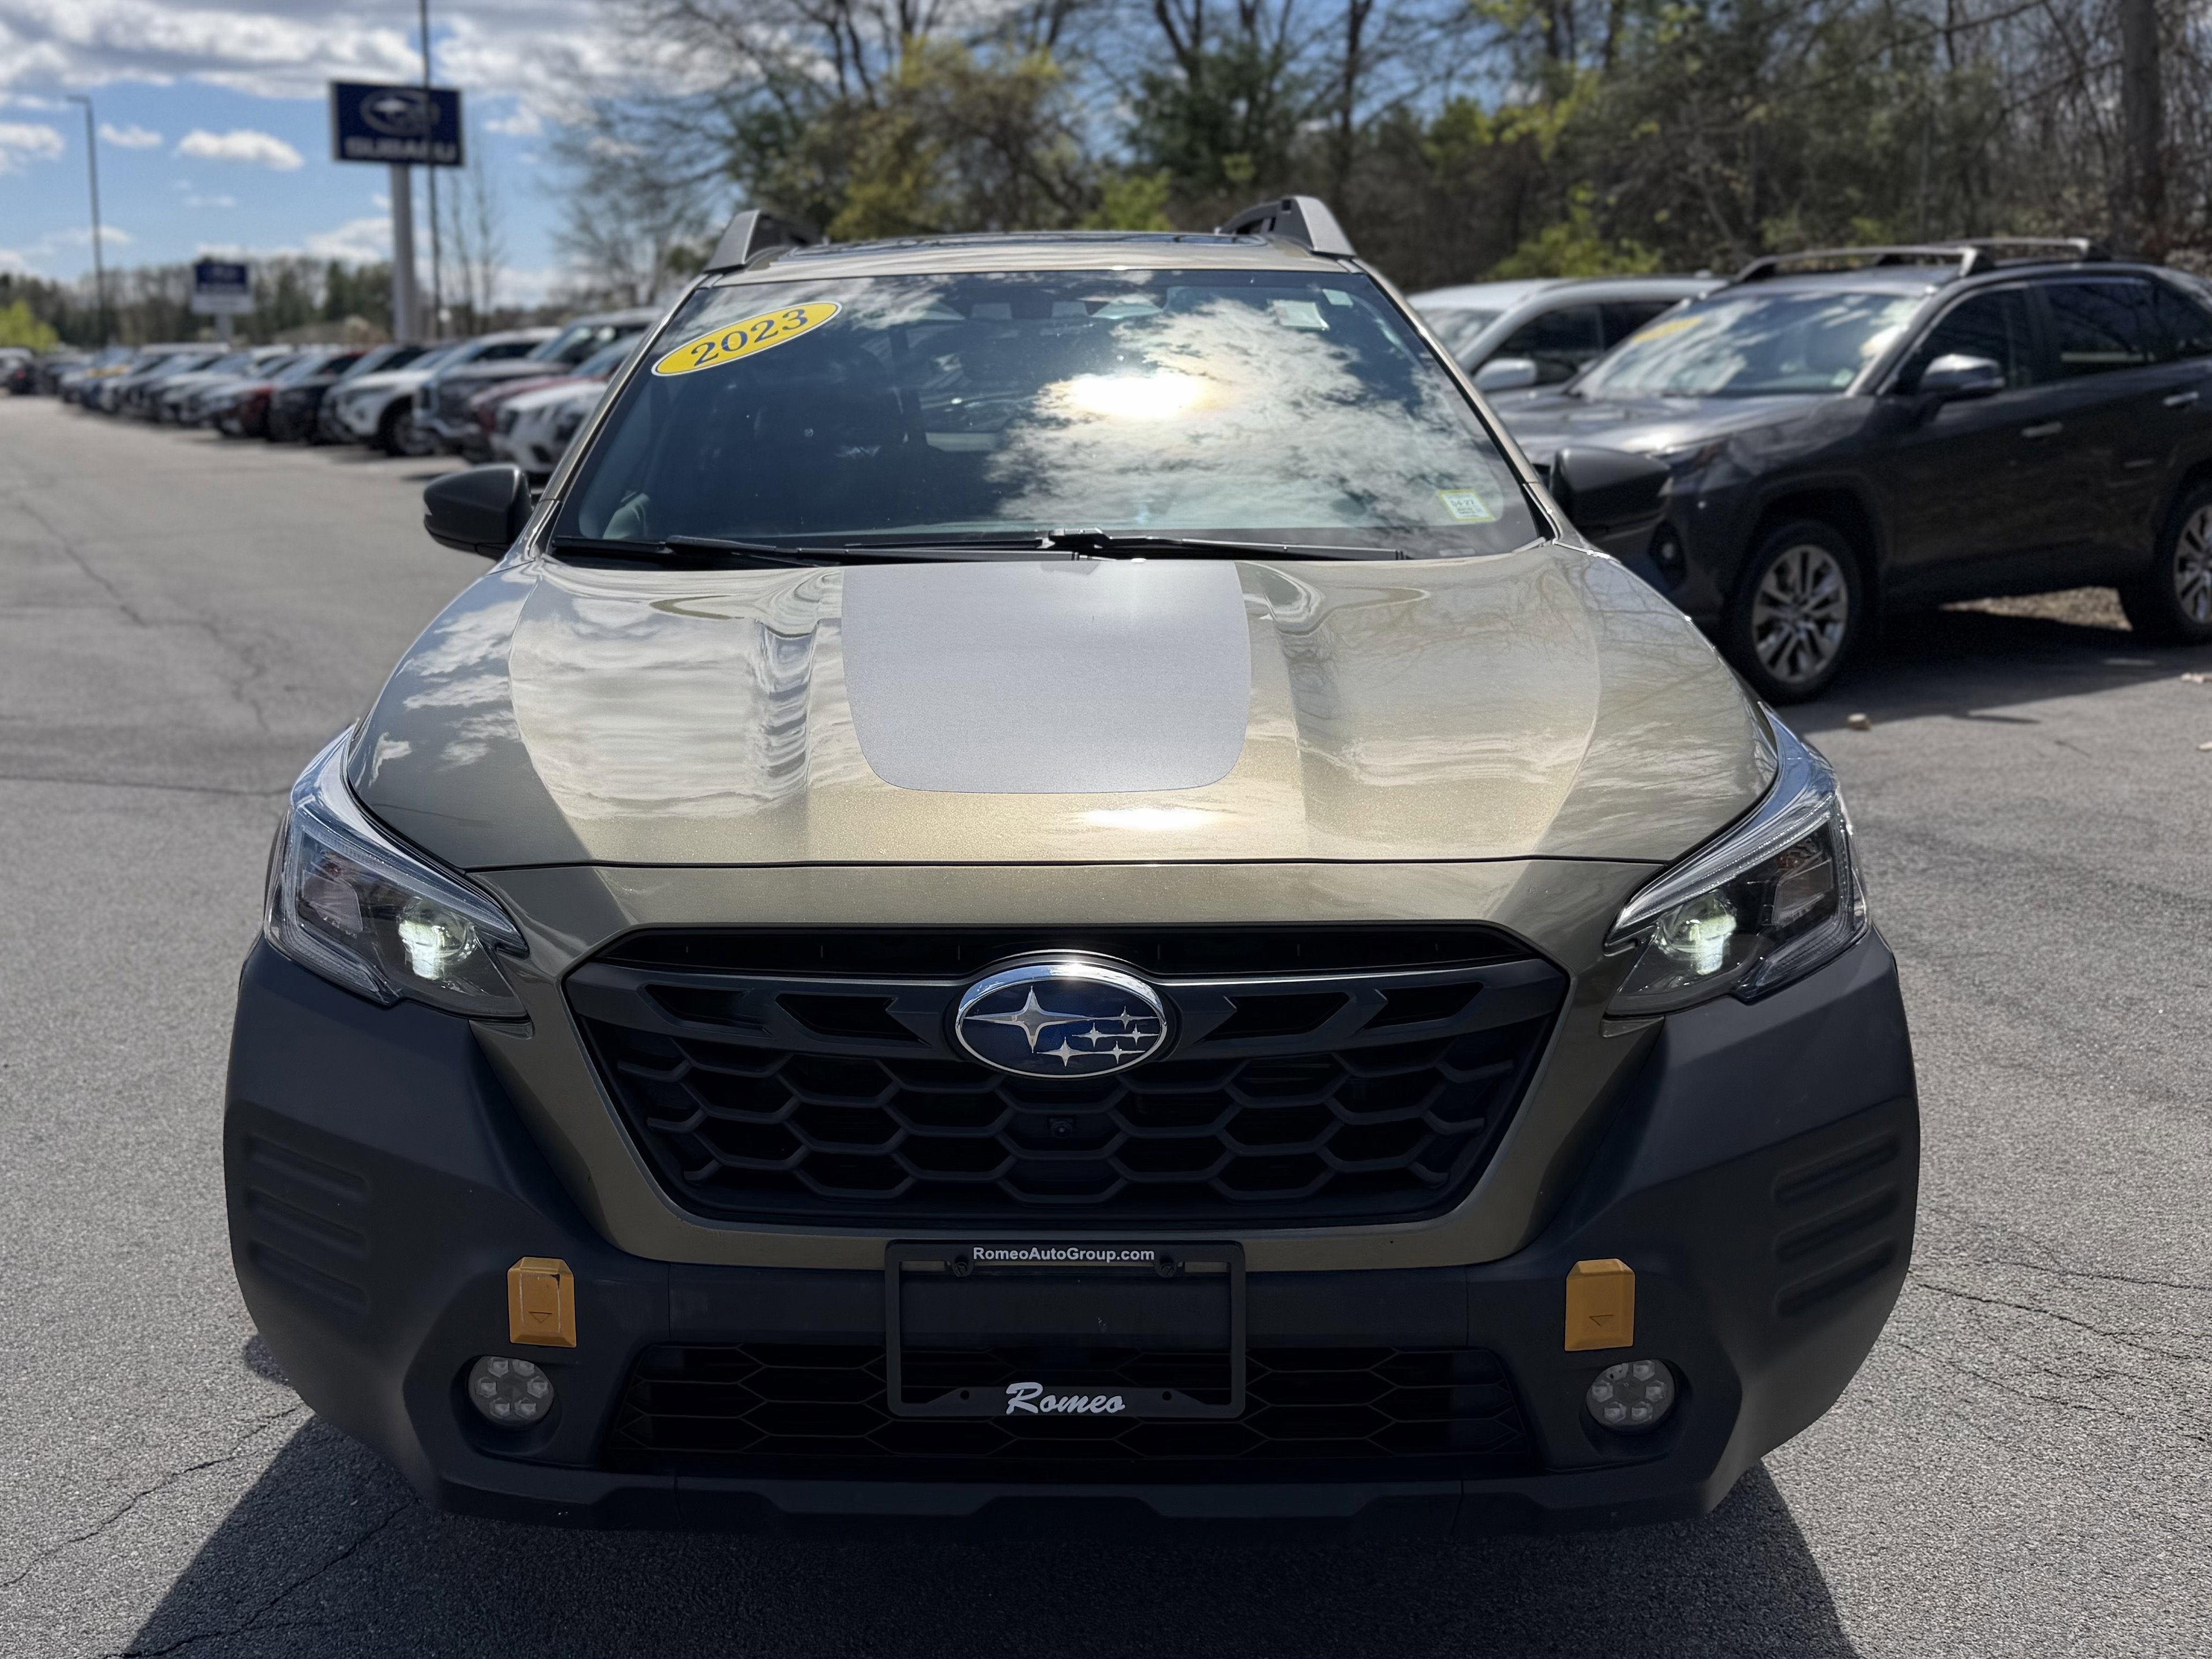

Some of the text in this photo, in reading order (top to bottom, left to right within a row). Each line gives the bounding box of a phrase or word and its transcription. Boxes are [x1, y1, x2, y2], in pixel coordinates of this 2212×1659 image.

[691, 309, 808, 367] 2023
[973, 1247, 1155, 1263] RomeoAutoGroup.com
[1006, 1382, 1125, 1415] Romeo
